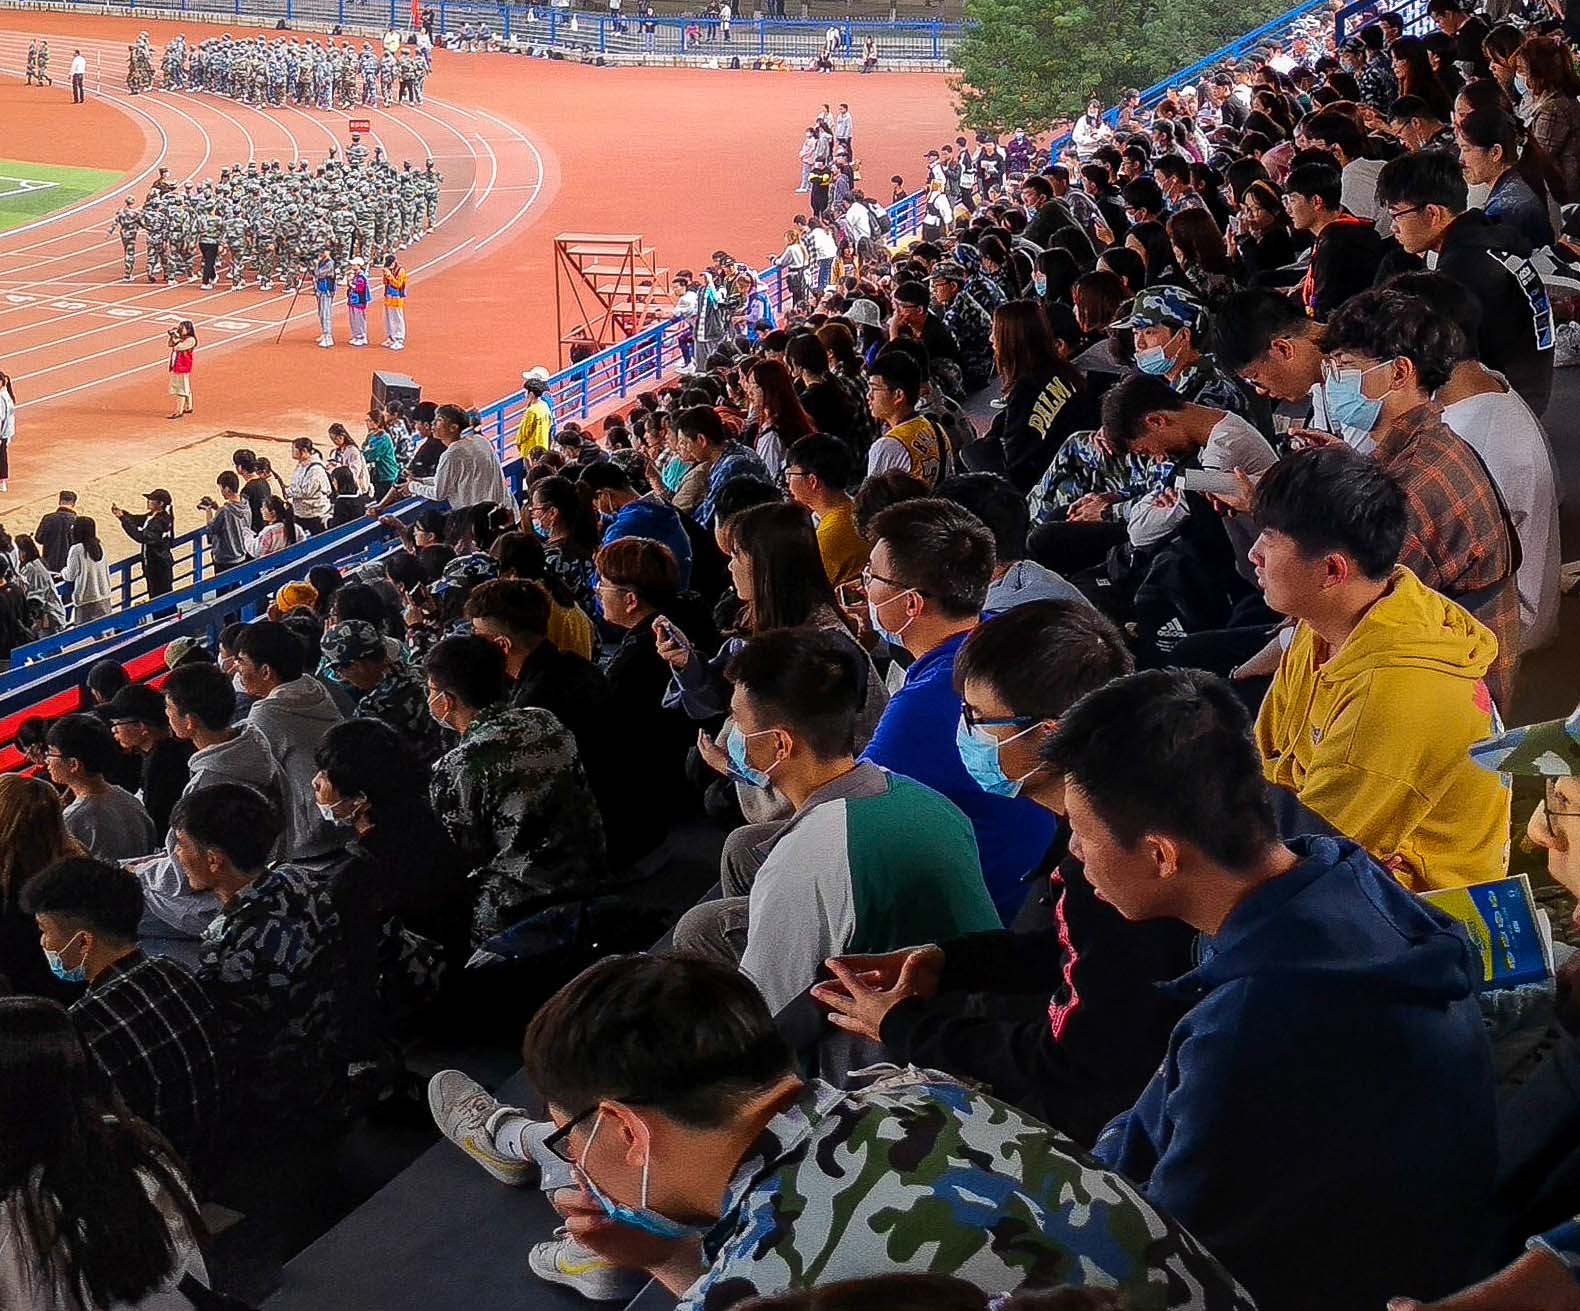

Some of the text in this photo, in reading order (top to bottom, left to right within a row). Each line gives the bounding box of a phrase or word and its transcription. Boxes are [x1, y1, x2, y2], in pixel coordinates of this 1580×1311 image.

[50, 301, 87, 310] 5
[107, 308, 144, 317] 6
[212, 320, 251, 330] 8
[1028, 375, 1072, 440] PALM
